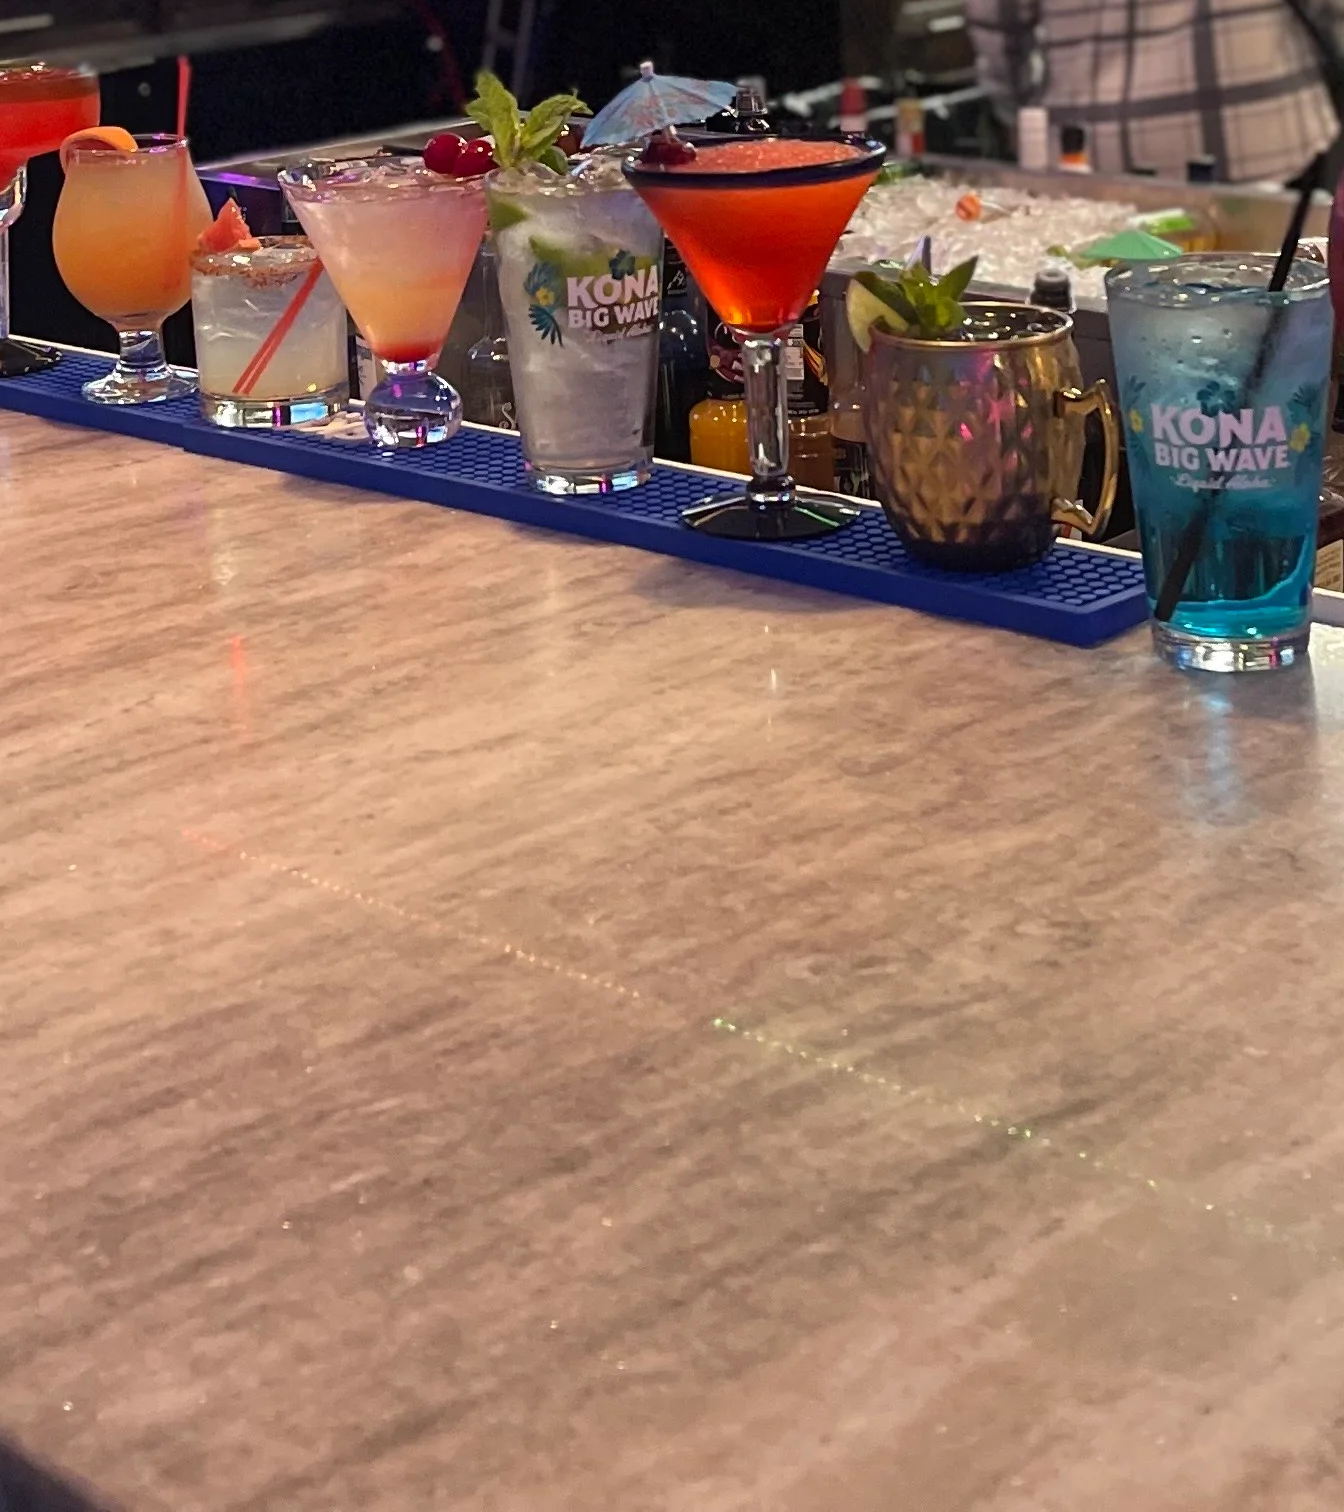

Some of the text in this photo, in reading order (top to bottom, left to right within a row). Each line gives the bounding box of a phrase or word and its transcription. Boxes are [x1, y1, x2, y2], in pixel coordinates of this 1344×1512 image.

[566, 264, 660, 309] KONA
[567, 296, 660, 329] BIG WAVE
[1150, 403, 1288, 448] KONA
[1154, 441, 1292, 473] BIG WAVE
